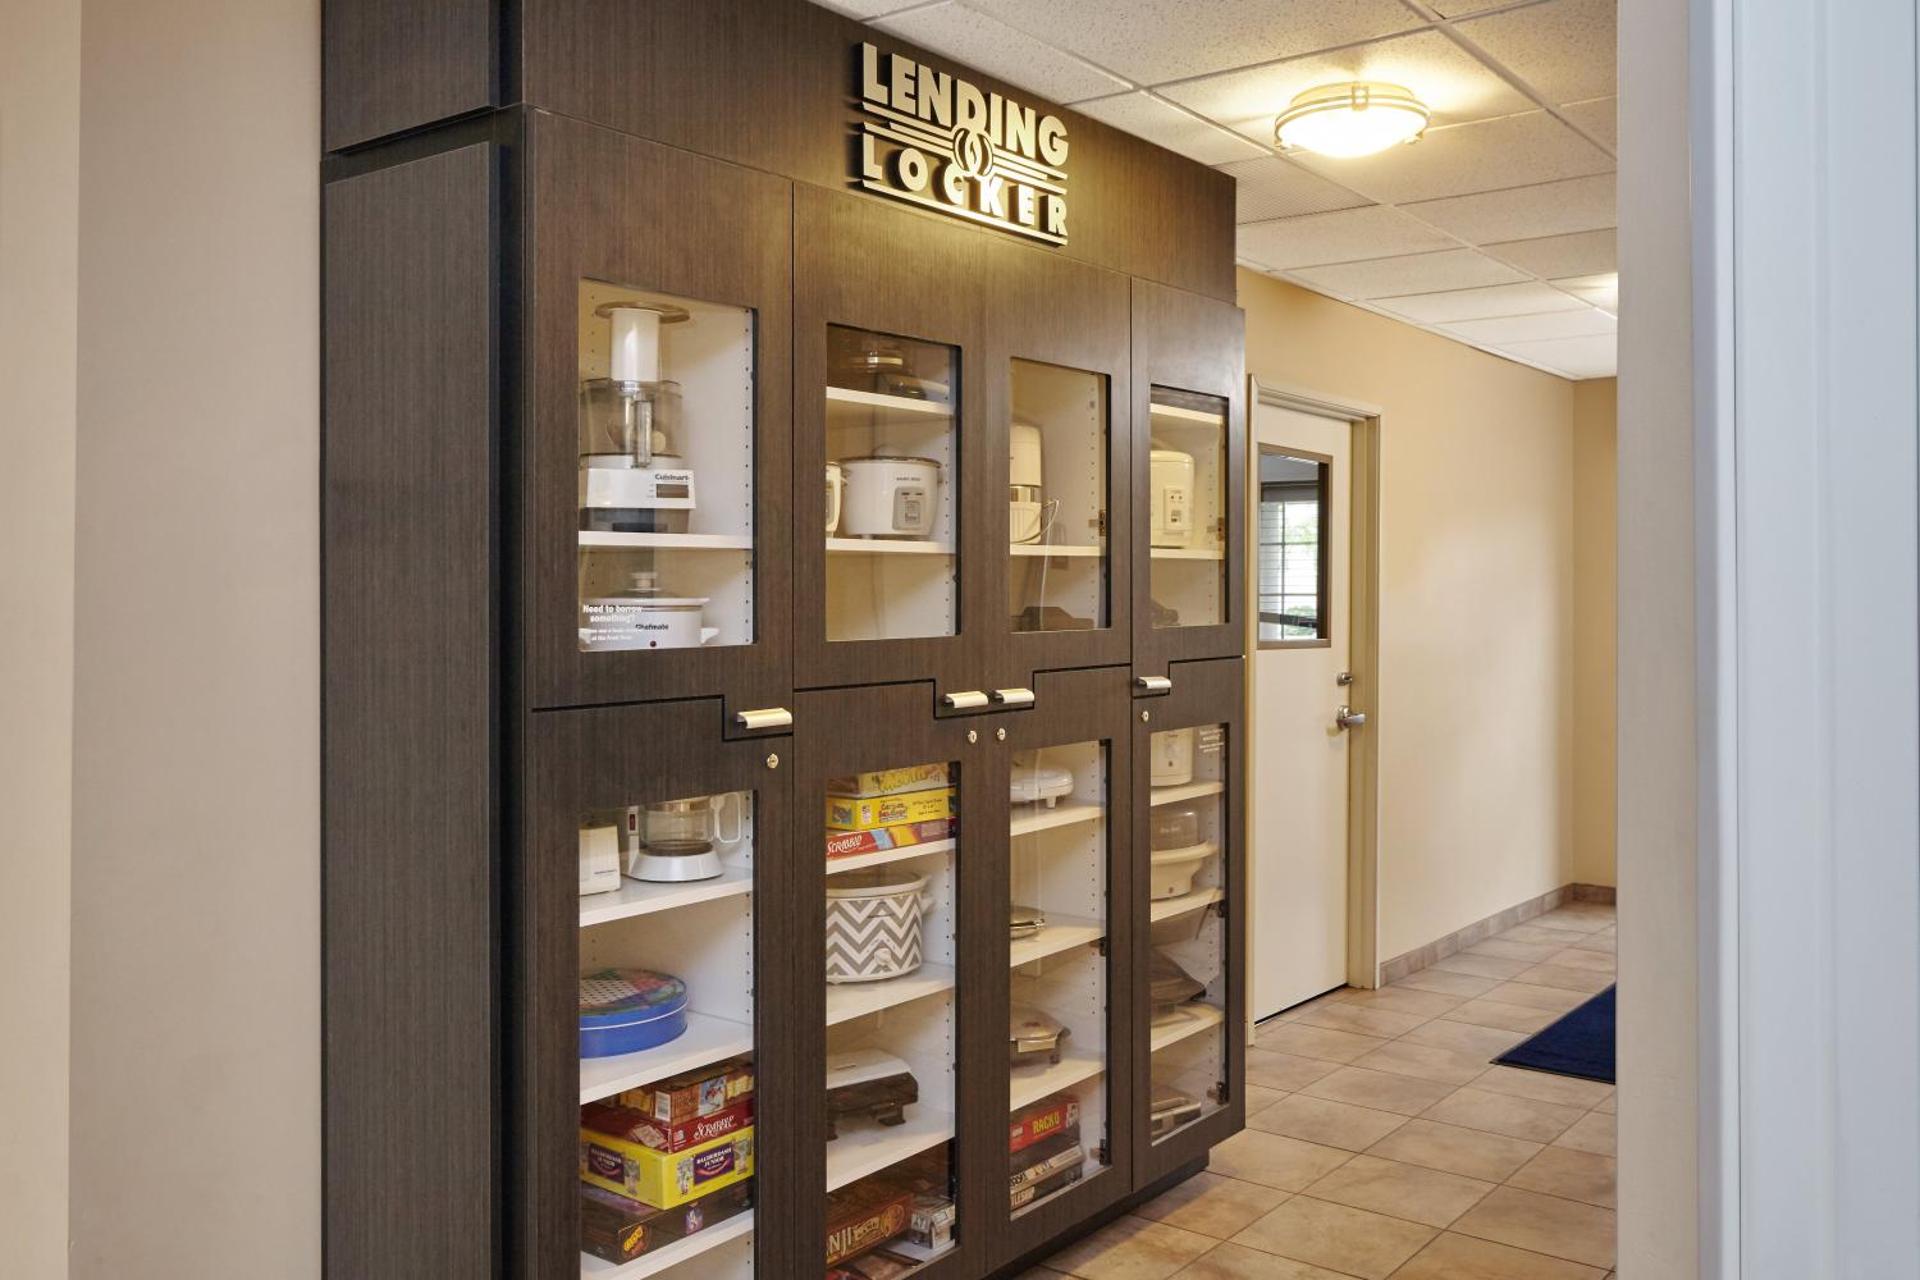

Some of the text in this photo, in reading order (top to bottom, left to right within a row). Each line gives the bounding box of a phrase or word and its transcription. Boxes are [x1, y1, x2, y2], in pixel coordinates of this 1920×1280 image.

[863, 42, 1069, 167] LENDING
[863, 132, 1068, 237] LOCKER
[583, 604, 603, 613] Need
[606, 604, 614, 613] to
